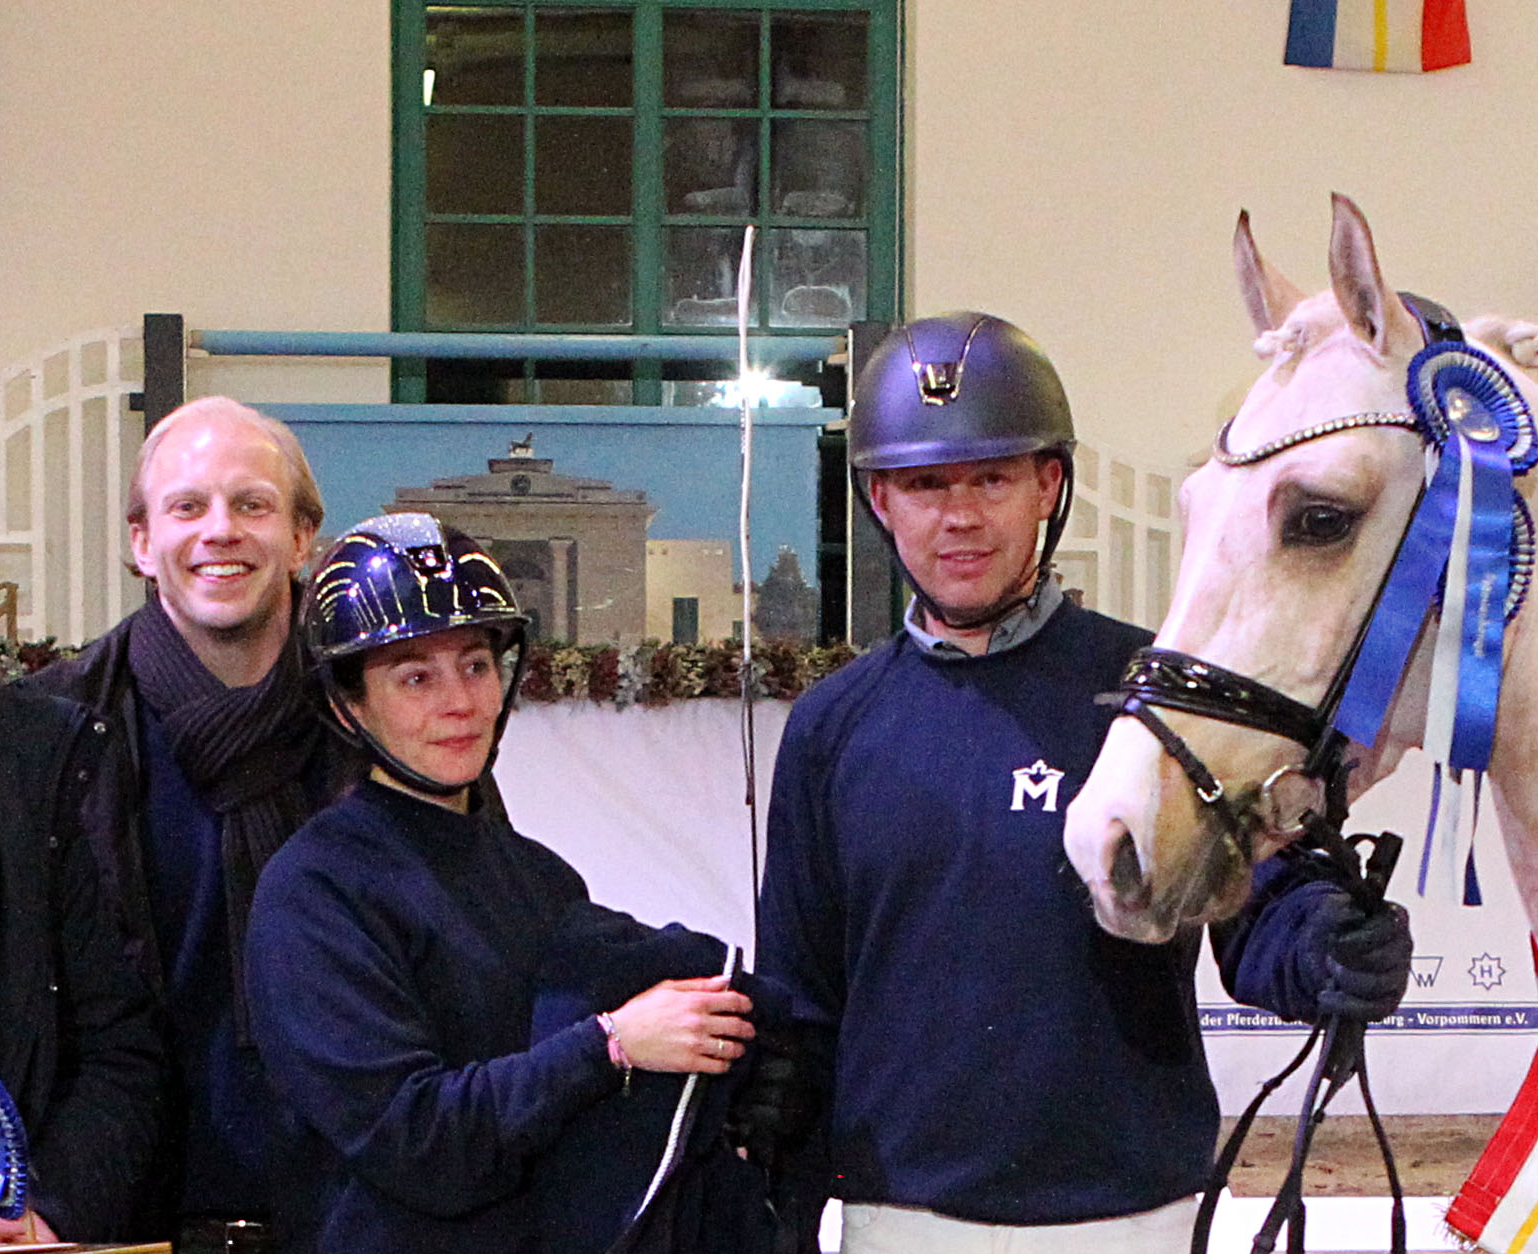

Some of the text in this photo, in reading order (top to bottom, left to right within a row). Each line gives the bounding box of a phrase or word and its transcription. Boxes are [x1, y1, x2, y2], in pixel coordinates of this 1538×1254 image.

[1010, 766, 1064, 812] M
[1200, 1013, 1223, 1026] der
[1417, 1012, 1503, 1027] Vorpommern
[1505, 1012, 1529, 1025] e.V.
